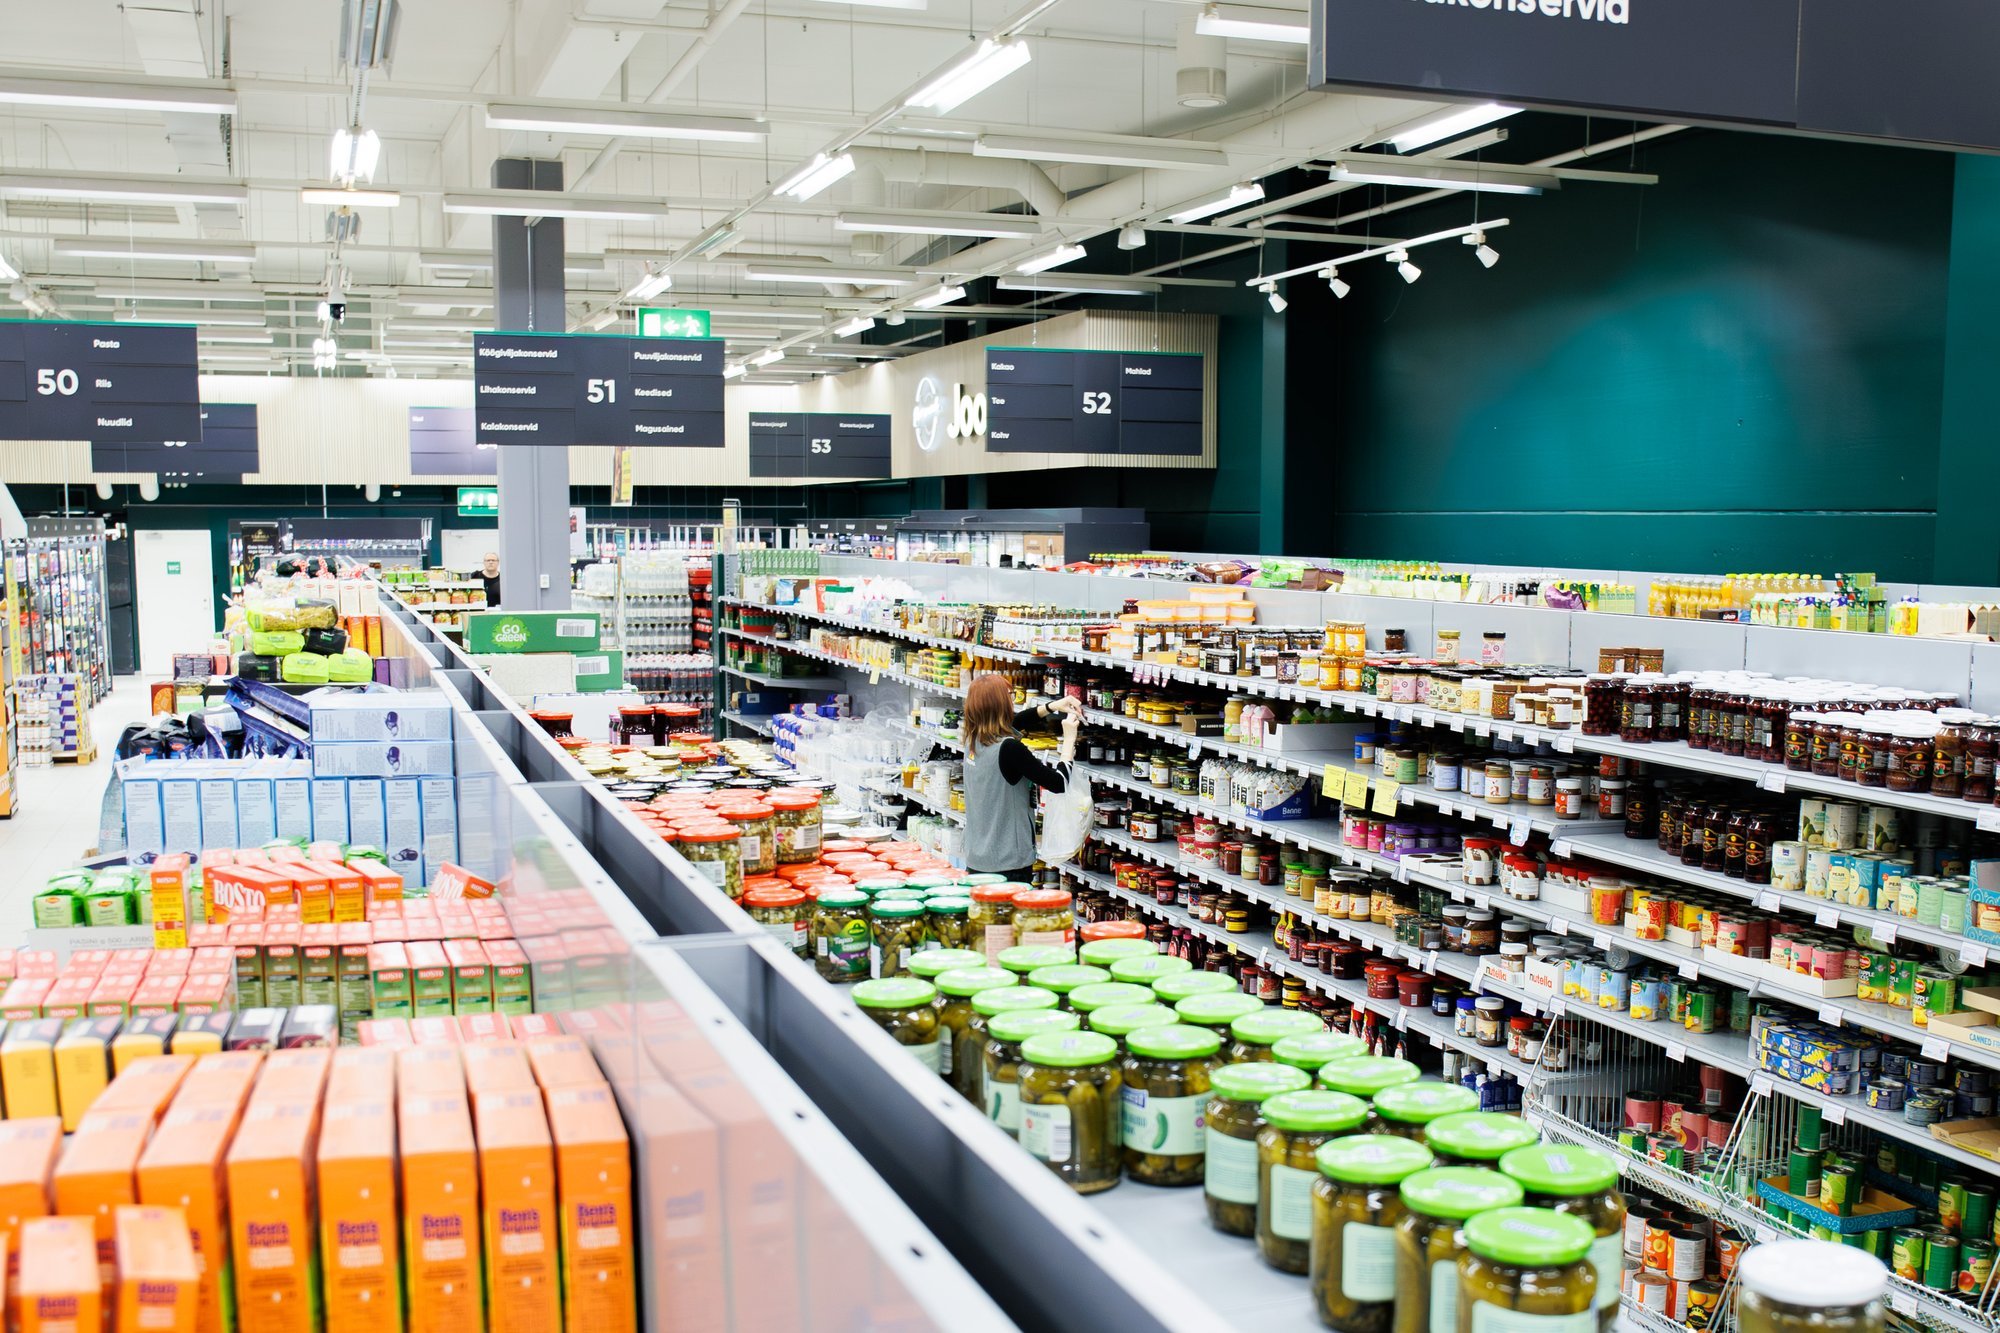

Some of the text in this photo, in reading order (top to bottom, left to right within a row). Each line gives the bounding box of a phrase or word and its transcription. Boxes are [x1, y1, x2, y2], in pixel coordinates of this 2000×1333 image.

[93, 339, 120, 349] Pasta
[479, 348, 558, 359] Köögiviljakonservid
[634, 351, 702, 362] Puuviljakonservid
[991, 362, 1015, 371] Kakao
[1125, 367, 1152, 376] Mahlad
[37, 368, 79, 396] 50
[95, 378, 112, 388] Riis
[480, 385, 537, 395] Lihakonservid
[587, 378, 616, 403] 51
[634, 388, 672, 397] Keedised
[991, 396, 1005, 405] Tee
[1082, 391, 1112, 414] 52
[97, 417, 133, 427] Nuudlid
[480, 421, 538, 432] Kalakonservid
[635, 424, 684, 434] Magusained
[991, 431, 1010, 440] Kohv
[811, 438, 832, 454] 53
[501, 624, 520, 634] GO
[213, 879, 266, 912] BOSTO
[1485, 966, 1507, 981] nutella
[1529, 973, 1553, 988] nutella
[1969, 1033, 1992, 1046] CANNED
